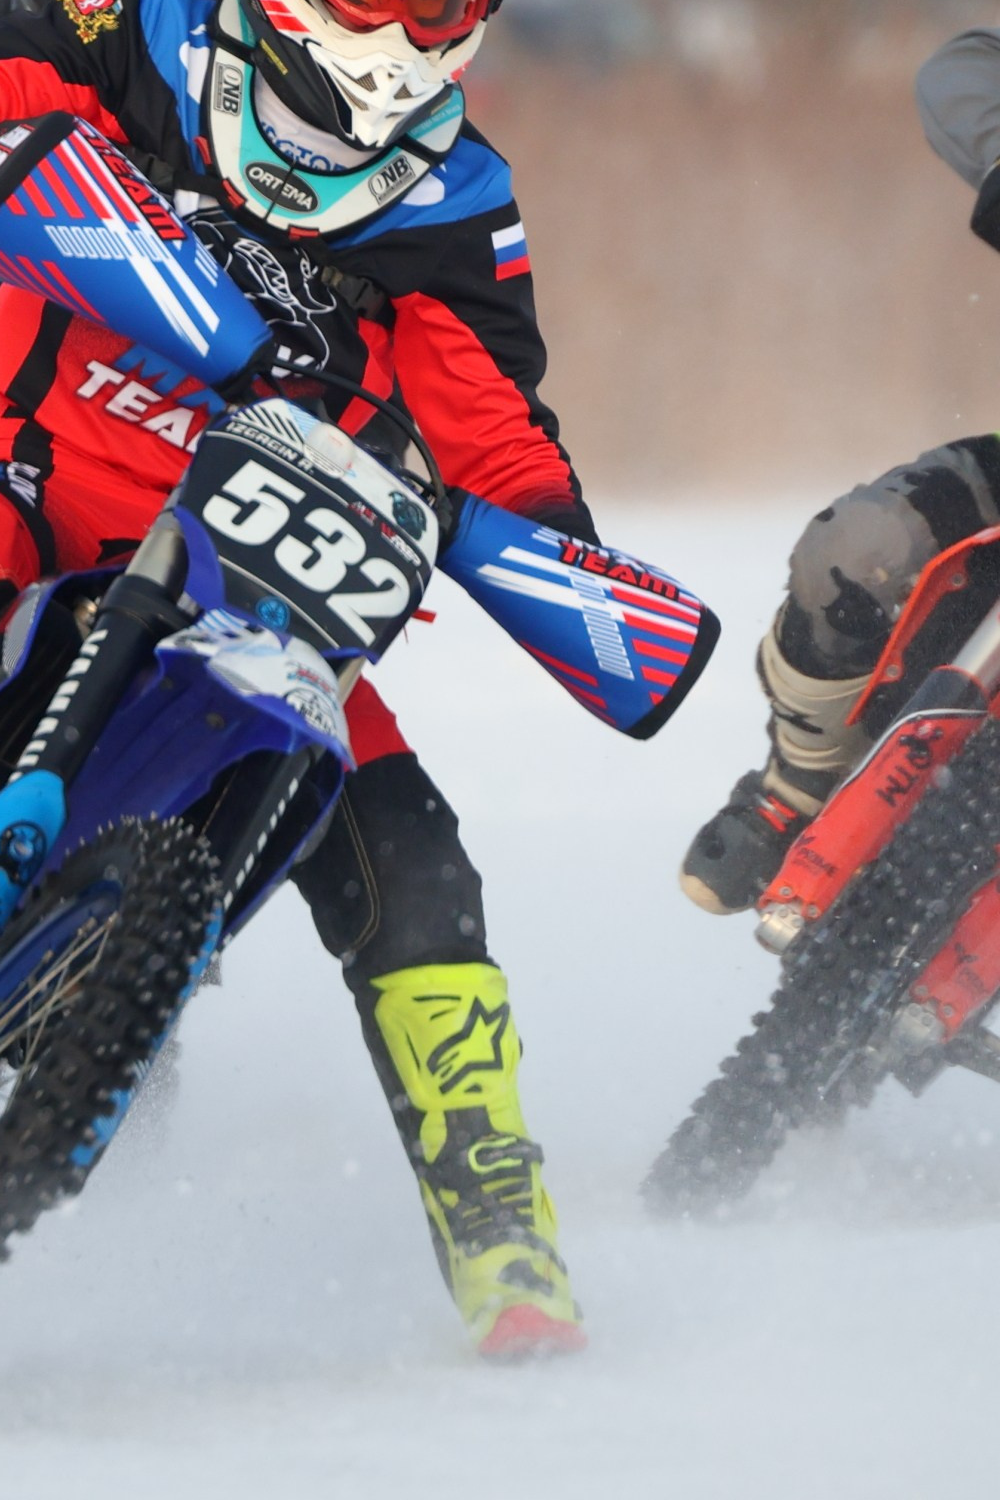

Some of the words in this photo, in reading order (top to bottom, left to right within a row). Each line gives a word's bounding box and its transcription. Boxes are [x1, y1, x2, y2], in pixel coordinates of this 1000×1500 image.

[221, 64, 241, 116] ONB
[248, 166, 314, 210] ORTEMA
[369, 156, 409, 195] ONB
[203, 460, 411, 649] 532
